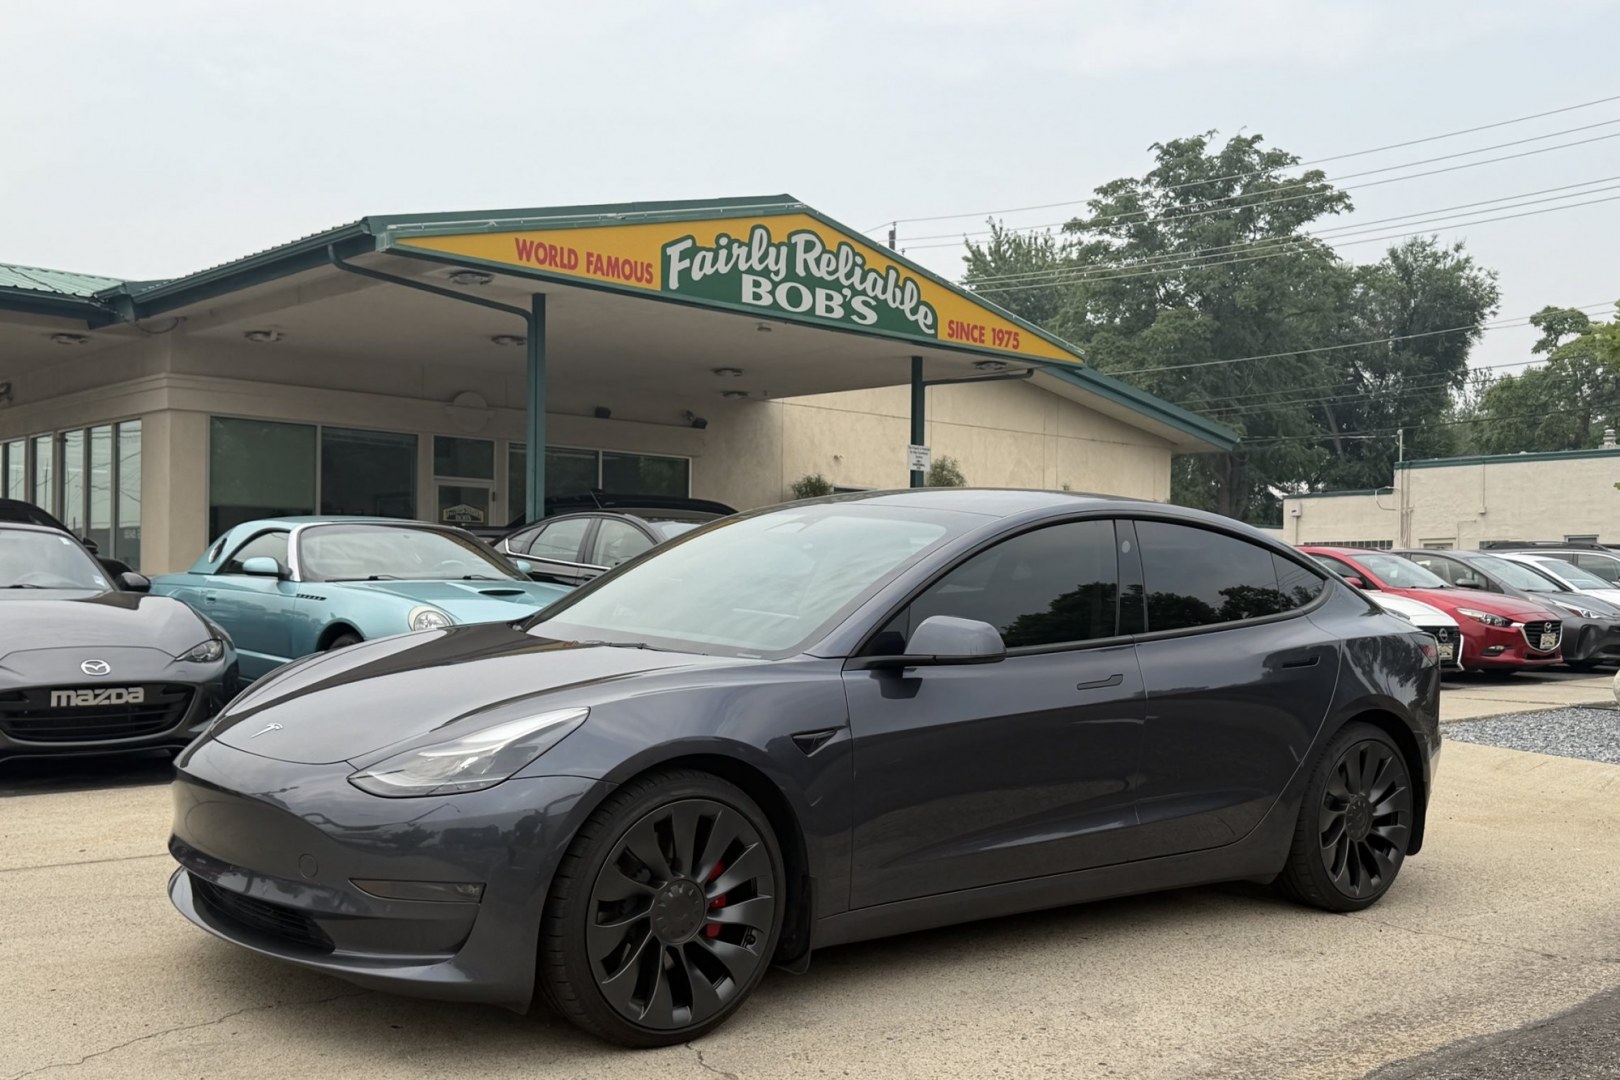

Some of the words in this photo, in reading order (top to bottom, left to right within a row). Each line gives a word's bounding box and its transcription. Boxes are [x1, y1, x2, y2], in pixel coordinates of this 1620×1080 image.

[515, 237, 578, 270] WORLD
[586, 252, 654, 285] FAMOUS
[666, 228, 788, 290] Fairly
[791, 232, 935, 334] Reliable
[741, 274, 879, 325] BOB'S
[947, 319, 985, 344] SINCE
[991, 327, 1020, 350] 1975
